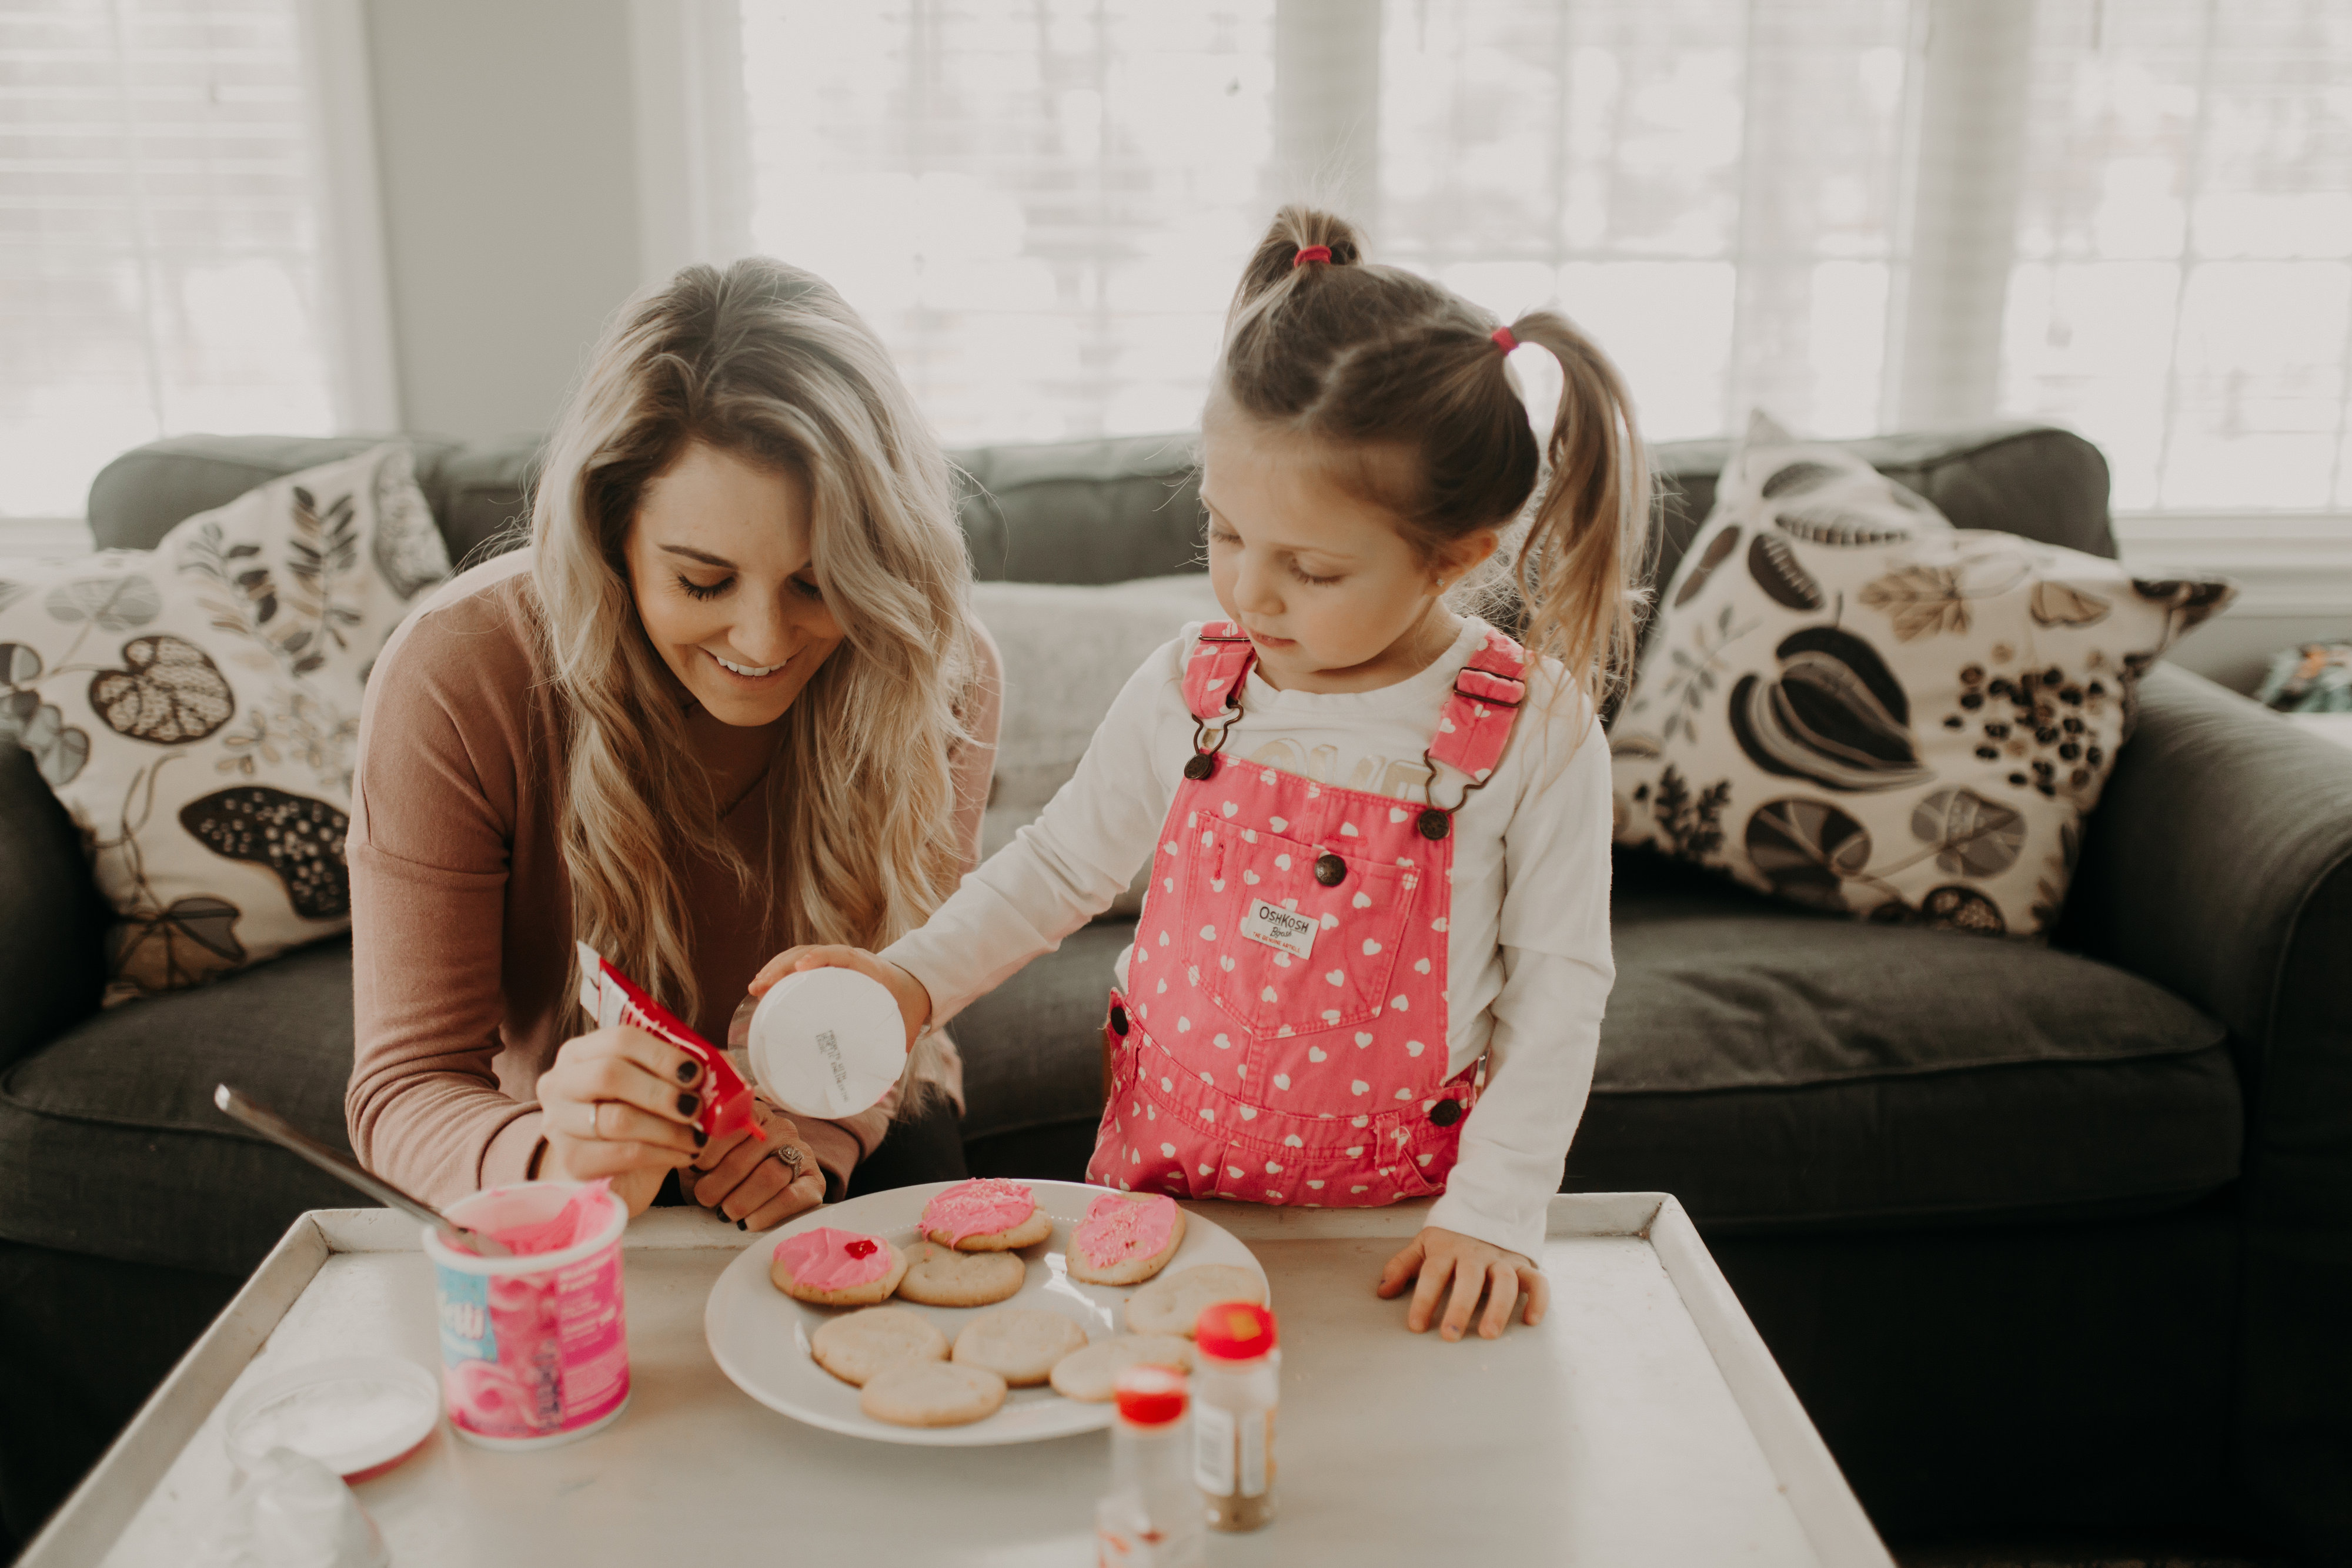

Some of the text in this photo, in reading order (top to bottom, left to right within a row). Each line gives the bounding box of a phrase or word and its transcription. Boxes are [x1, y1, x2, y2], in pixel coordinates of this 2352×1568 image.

[1253, 931, 1301, 954] THE GENUINE ARTICLE
